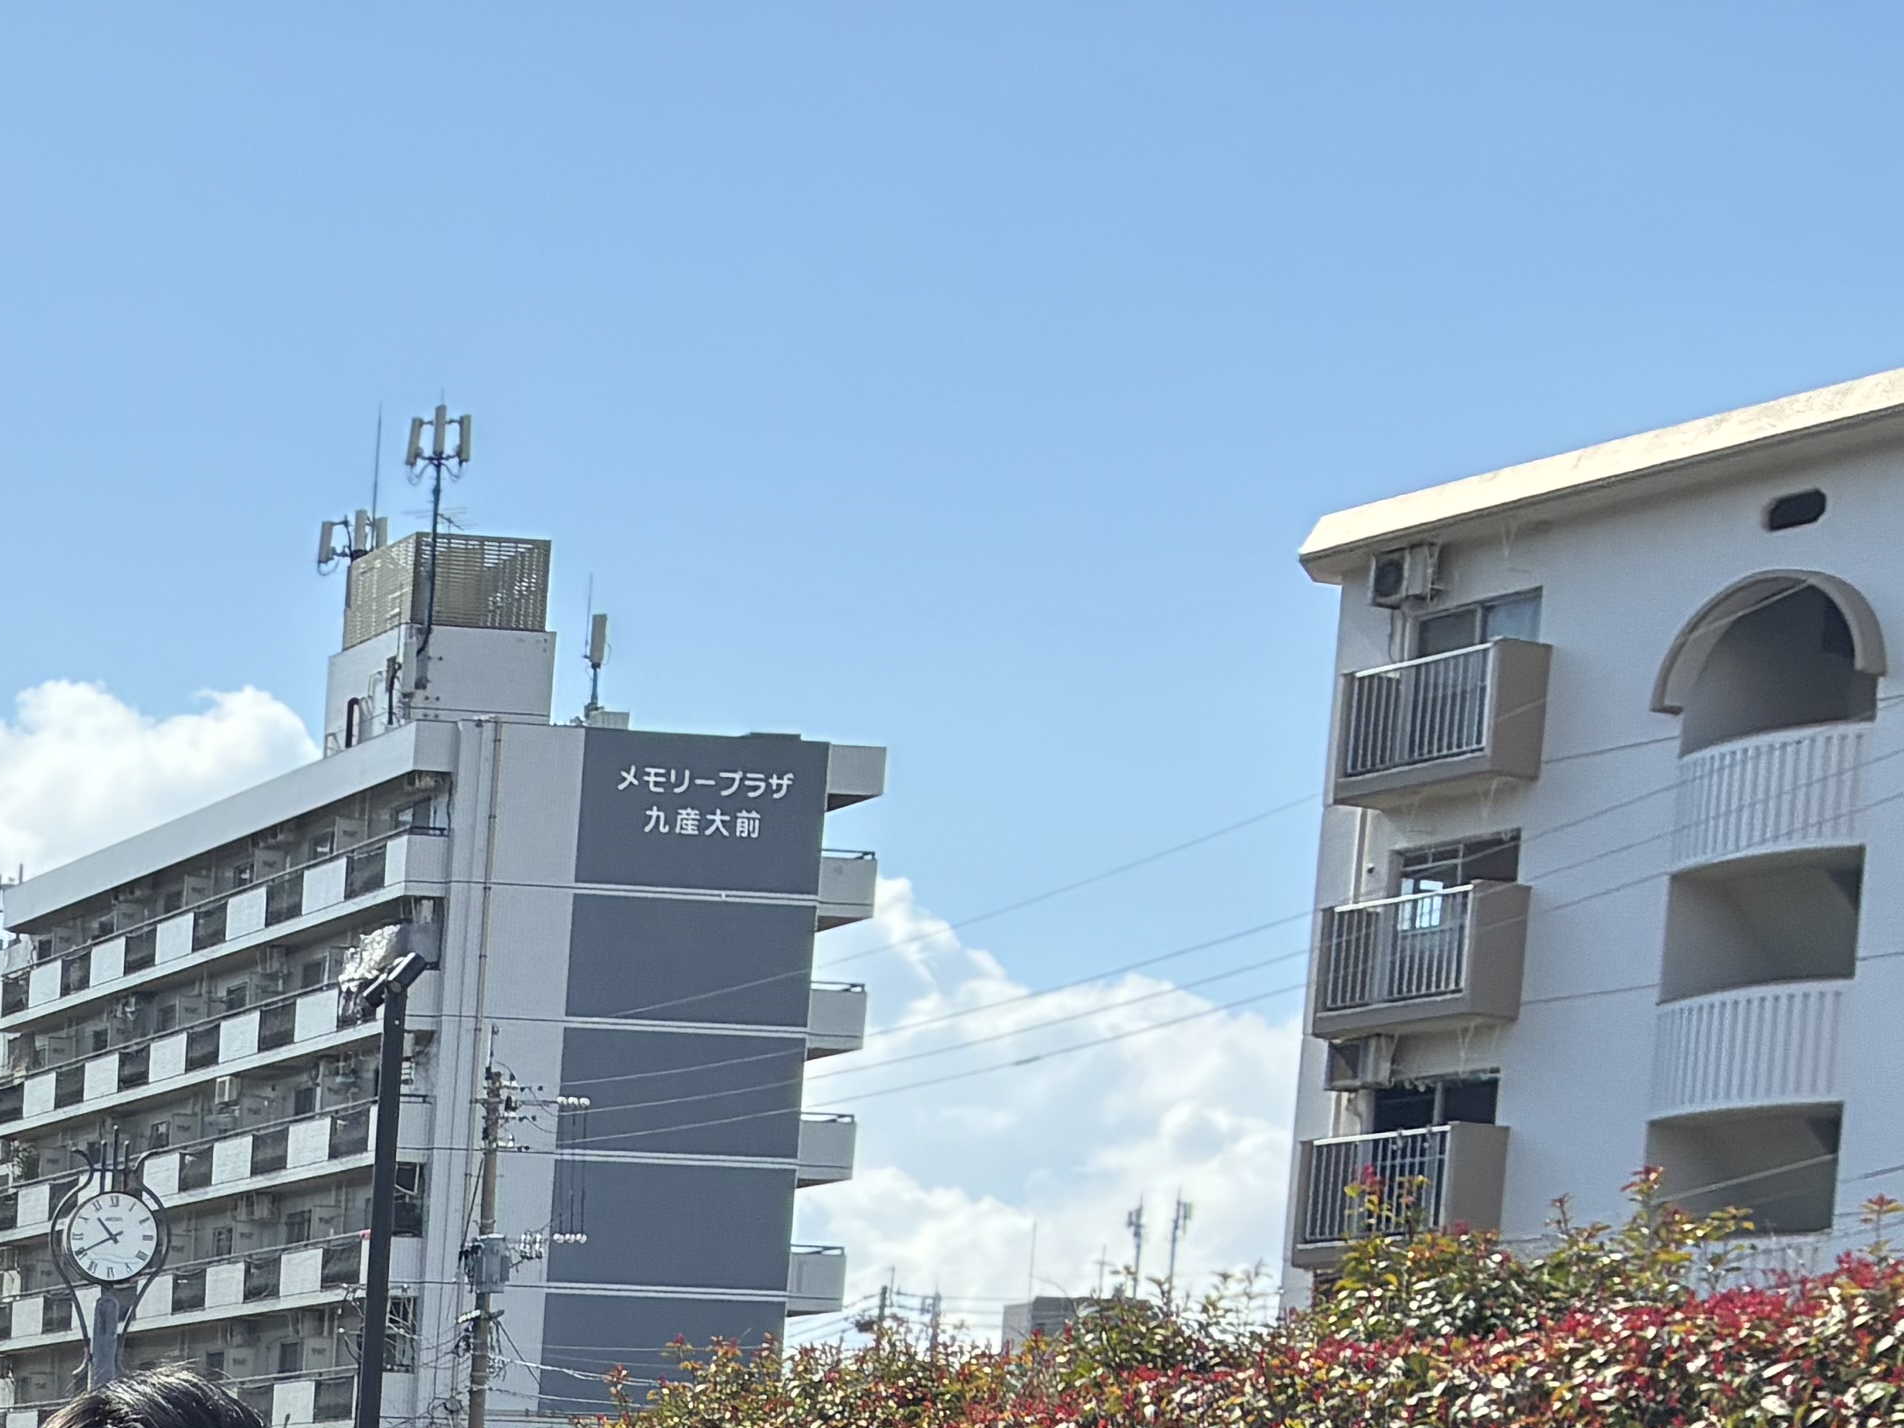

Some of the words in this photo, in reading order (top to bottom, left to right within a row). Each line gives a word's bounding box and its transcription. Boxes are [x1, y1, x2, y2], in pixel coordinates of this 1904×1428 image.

[617, 764, 795, 799] メモリープラザ
[643, 805, 761, 839] 九産大前
